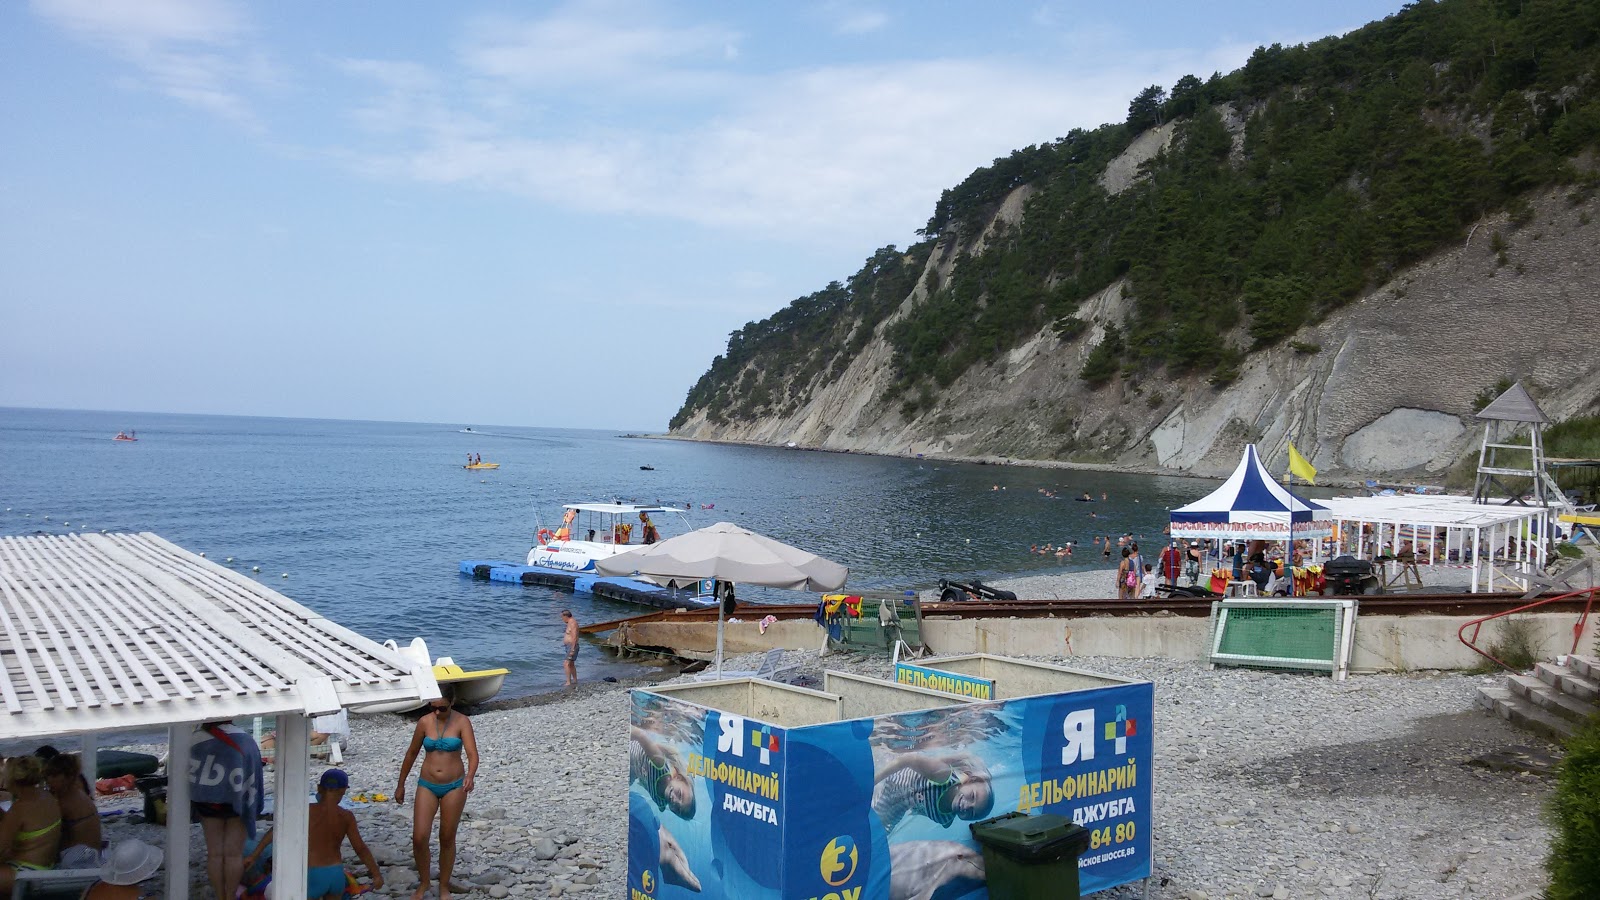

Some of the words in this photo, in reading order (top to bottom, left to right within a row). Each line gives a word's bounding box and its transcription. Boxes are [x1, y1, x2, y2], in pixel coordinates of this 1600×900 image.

[1208, 521, 1247, 532] ПРОГУЛКИ
[717, 712, 744, 757] Я
[1062, 708, 1095, 765] Я
[686, 753, 779, 801] ДЕЛЬФИНАРИЙ
[1016, 758, 1136, 814] ДЕЛЬФИНАРИЙ
[723, 793, 778, 826] ДЖУБГА
[1072, 796, 1136, 827] ДЖУБГА
[1090, 827, 1111, 849] 84
[1115, 821, 1135, 844] 80
[1078, 855, 1101, 868] ЙСКОЕ
